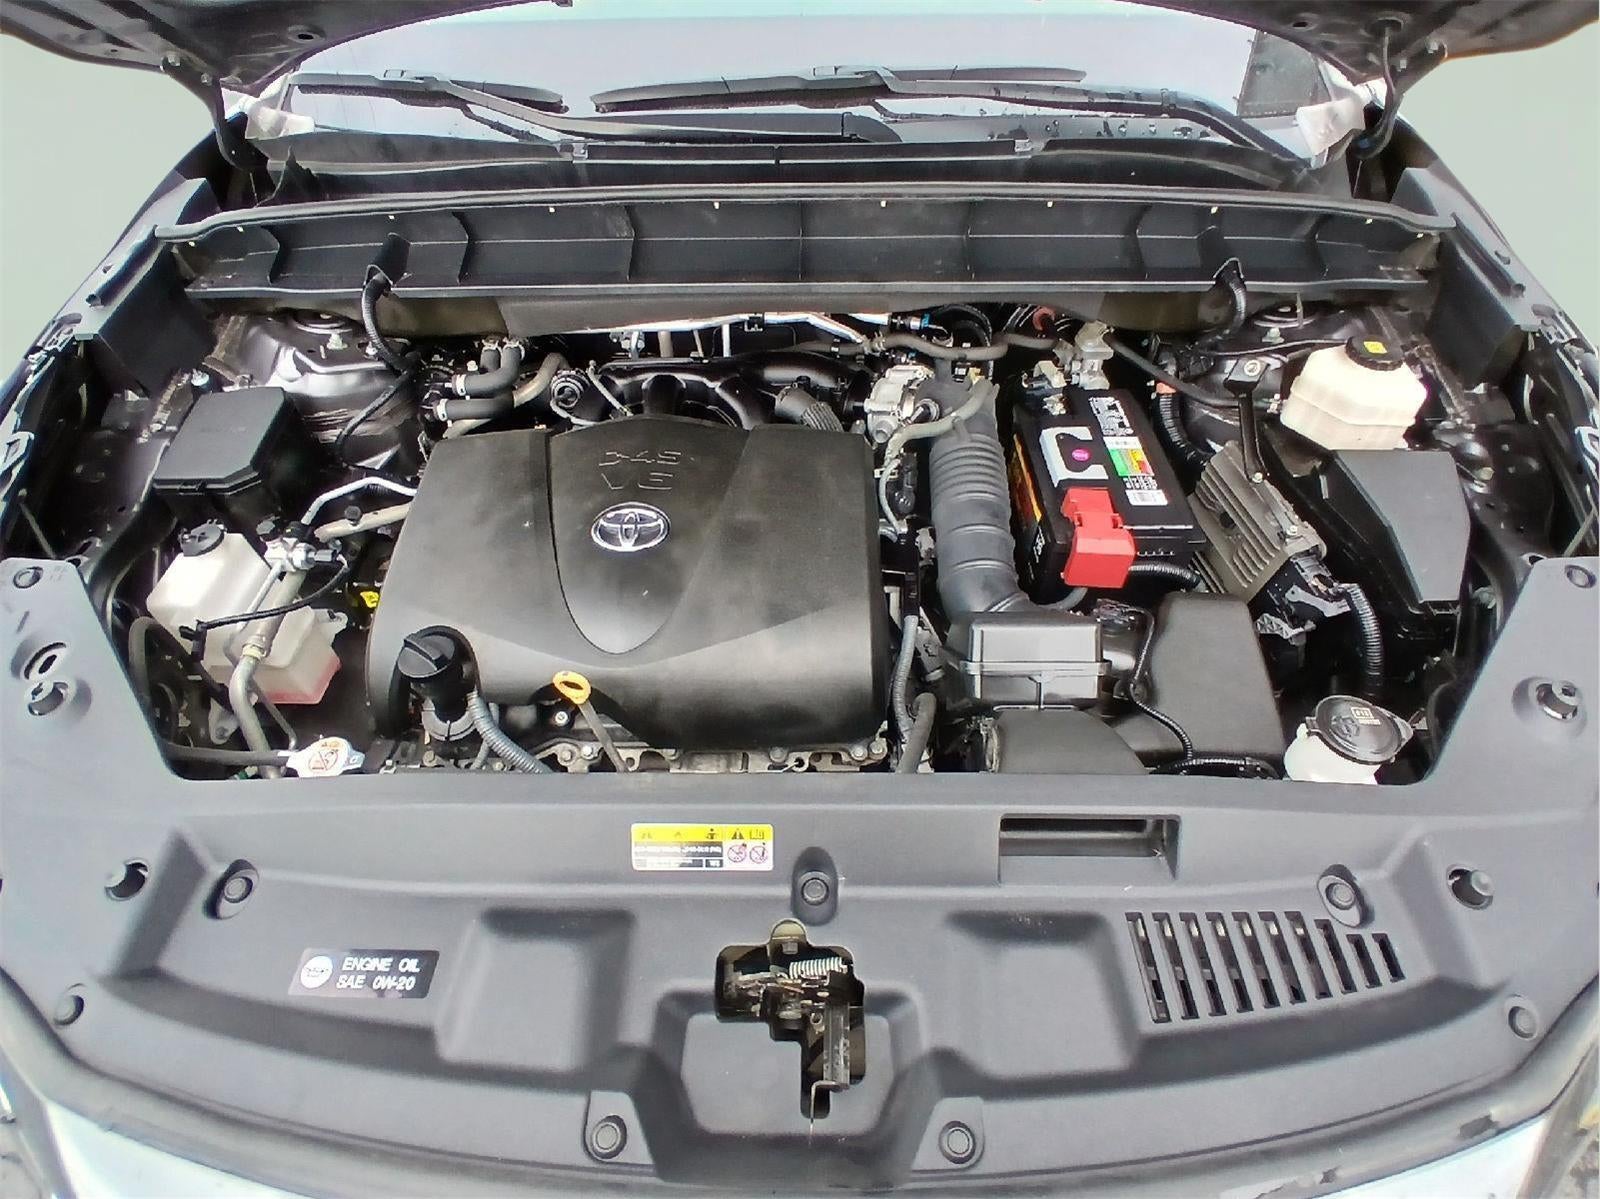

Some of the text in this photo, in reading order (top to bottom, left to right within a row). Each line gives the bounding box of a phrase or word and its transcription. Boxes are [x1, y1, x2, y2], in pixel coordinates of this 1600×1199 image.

[342, 957, 420, 972] ENGINE OIL
[336, 975, 416, 991] SAE 0W-20
